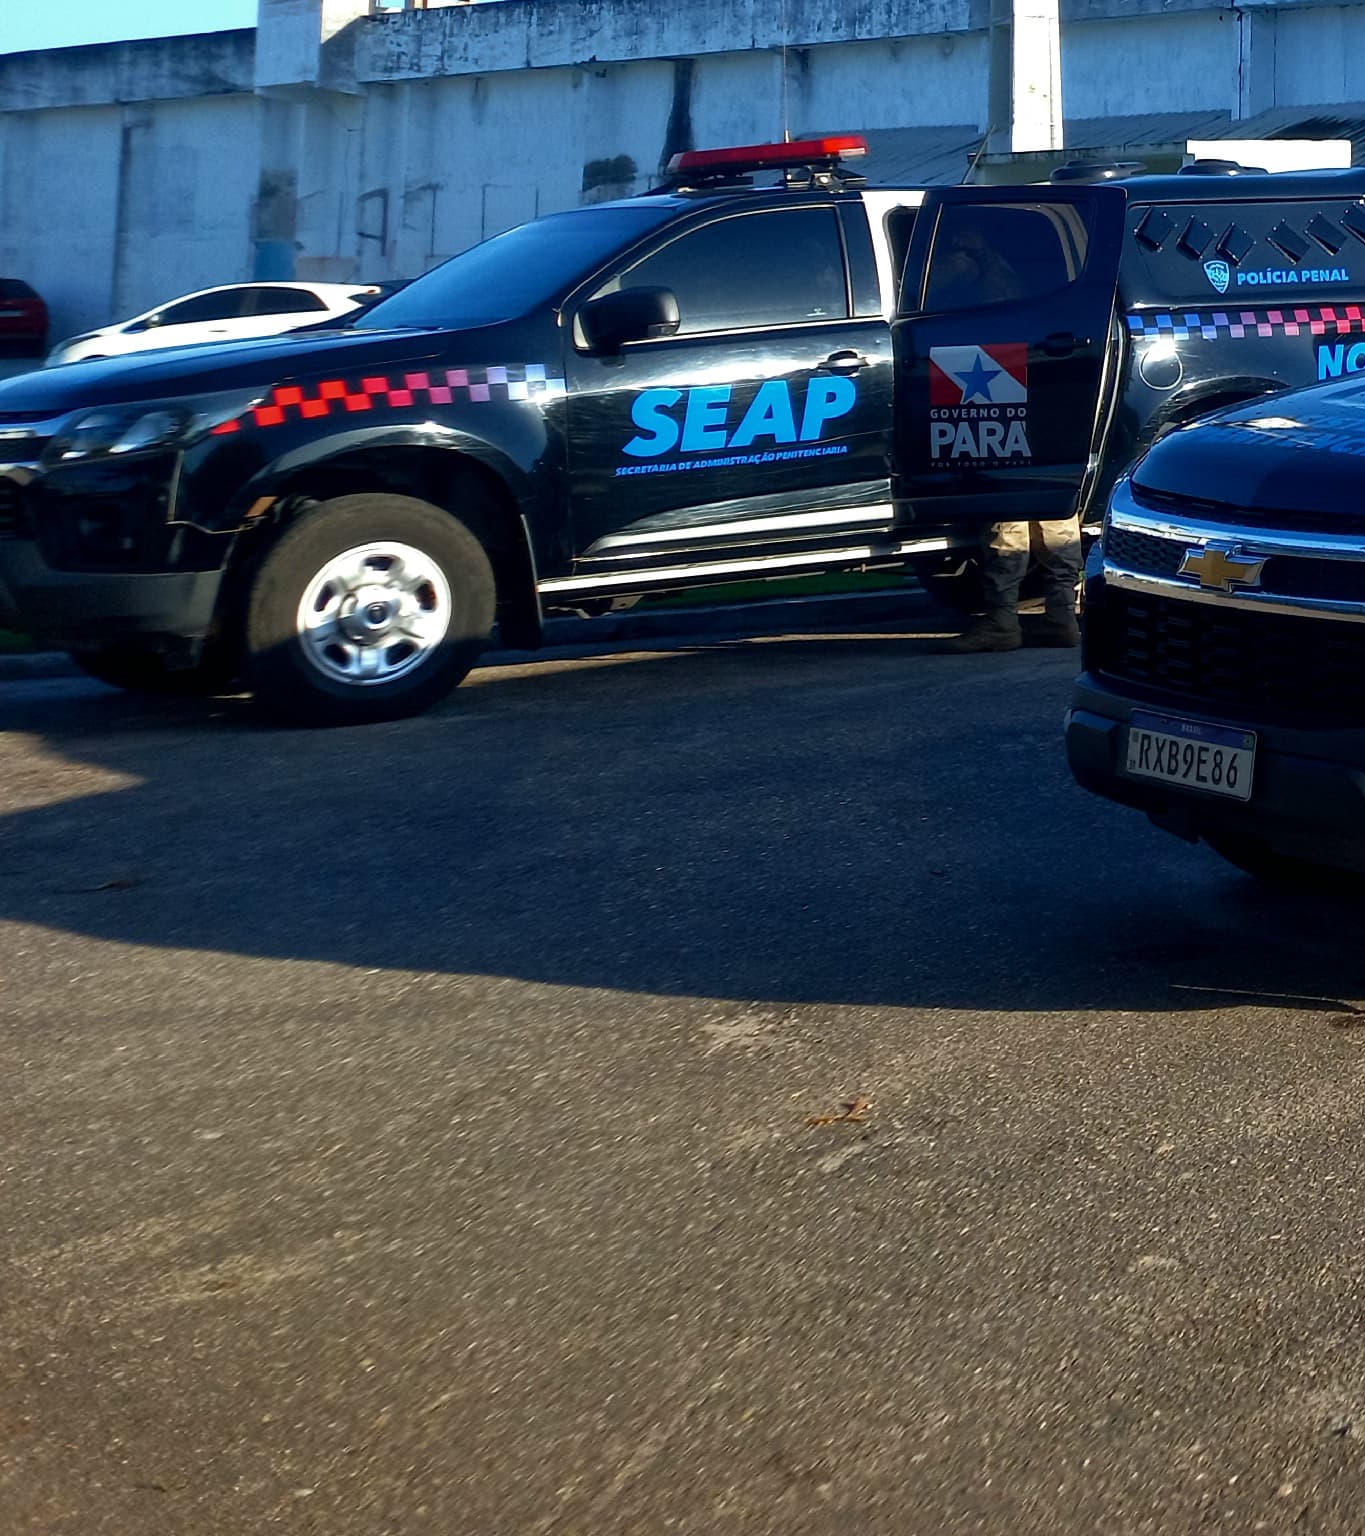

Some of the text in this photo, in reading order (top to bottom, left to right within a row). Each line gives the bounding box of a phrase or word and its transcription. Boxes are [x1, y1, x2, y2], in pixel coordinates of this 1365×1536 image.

[1237, 268, 1349, 285] POLÍCIA PENAL
[622, 376, 856, 457] SEAP
[930, 407, 1027, 419] GOVERNO DO
[930, 420, 1032, 459] PARÁ
[615, 463, 677, 477] SECRETARIA
[679, 461, 692, 471] DE
[1138, 733, 1239, 789] RXB9E86
